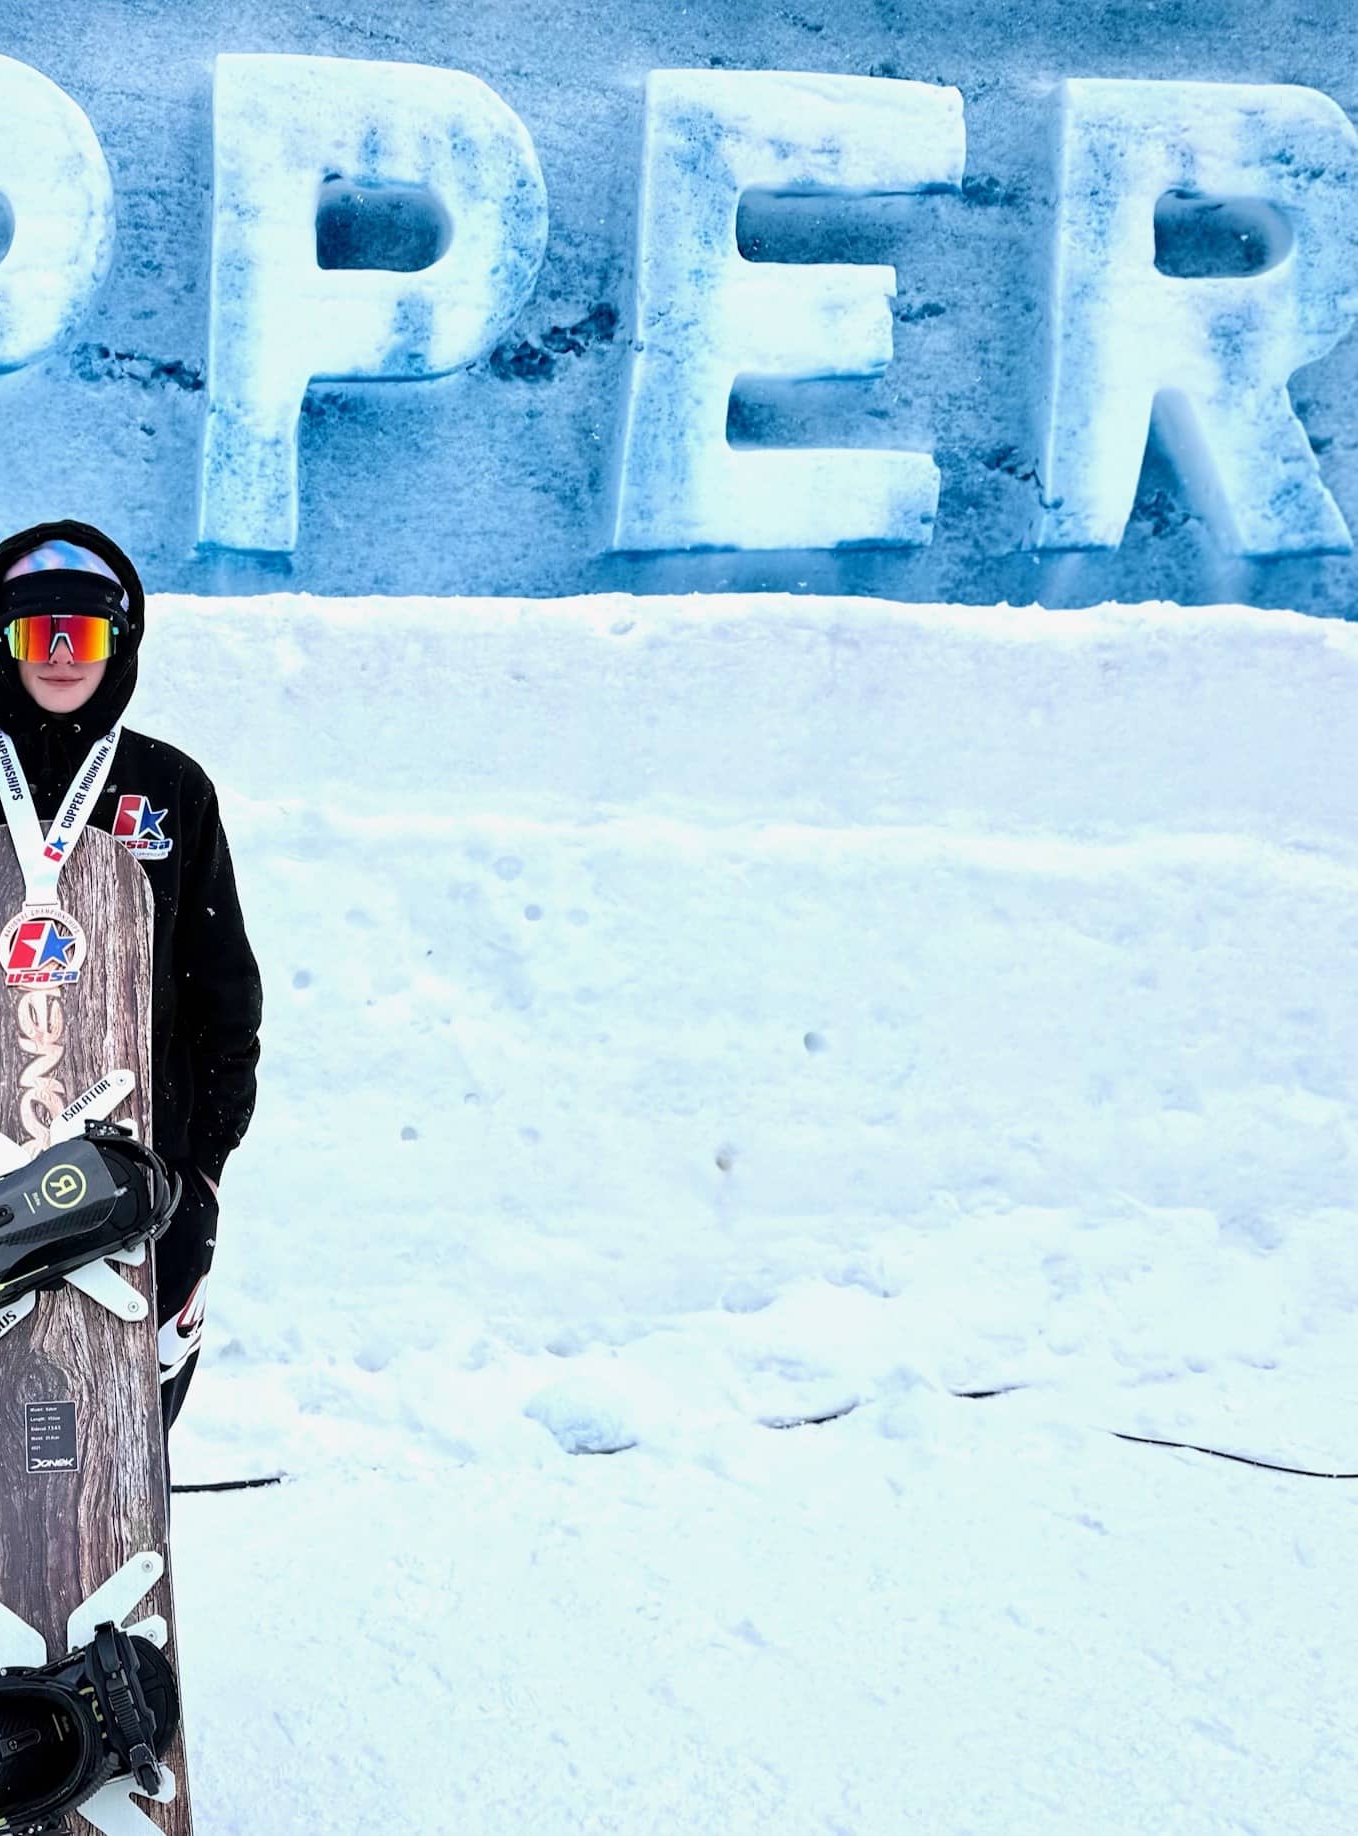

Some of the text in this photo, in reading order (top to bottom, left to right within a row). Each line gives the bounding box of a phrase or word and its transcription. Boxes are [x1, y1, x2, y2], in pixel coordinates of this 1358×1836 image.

[60, 792, 86, 829] COPPER
[79, 745, 112, 792] MOUNTAIN,
[126, 840, 170, 849] sasa
[61, 1079, 111, 1122] ISOLATOR
